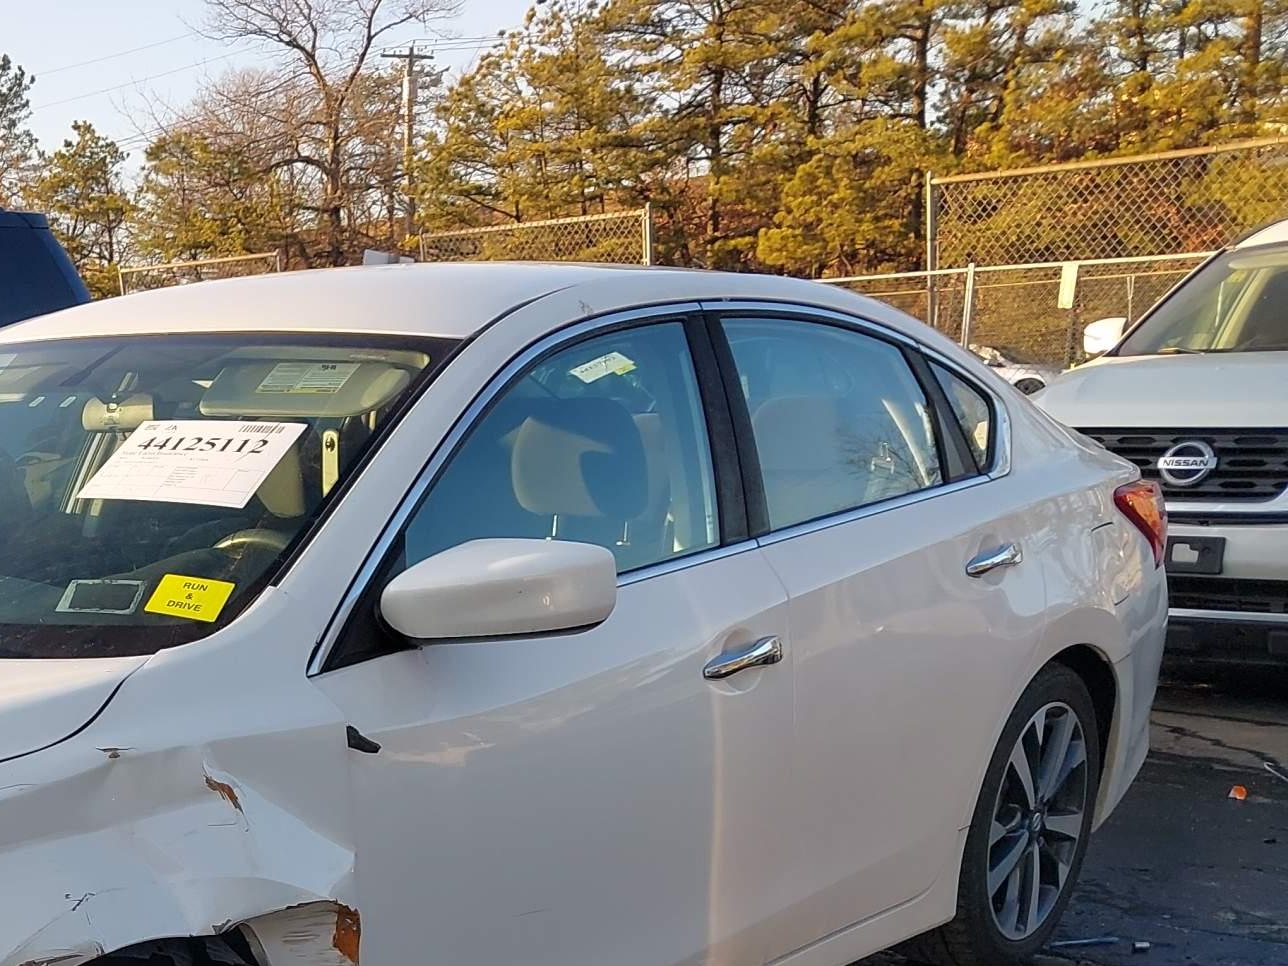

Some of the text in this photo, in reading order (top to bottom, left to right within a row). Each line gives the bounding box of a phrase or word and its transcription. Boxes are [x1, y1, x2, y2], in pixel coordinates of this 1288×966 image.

[137, 436, 269, 454] 44125112
[1162, 459, 1208, 467] NISSAN
[183, 582, 209, 592] RUN
[185, 592, 194, 600] &
[166, 600, 202, 612] DRIVE
